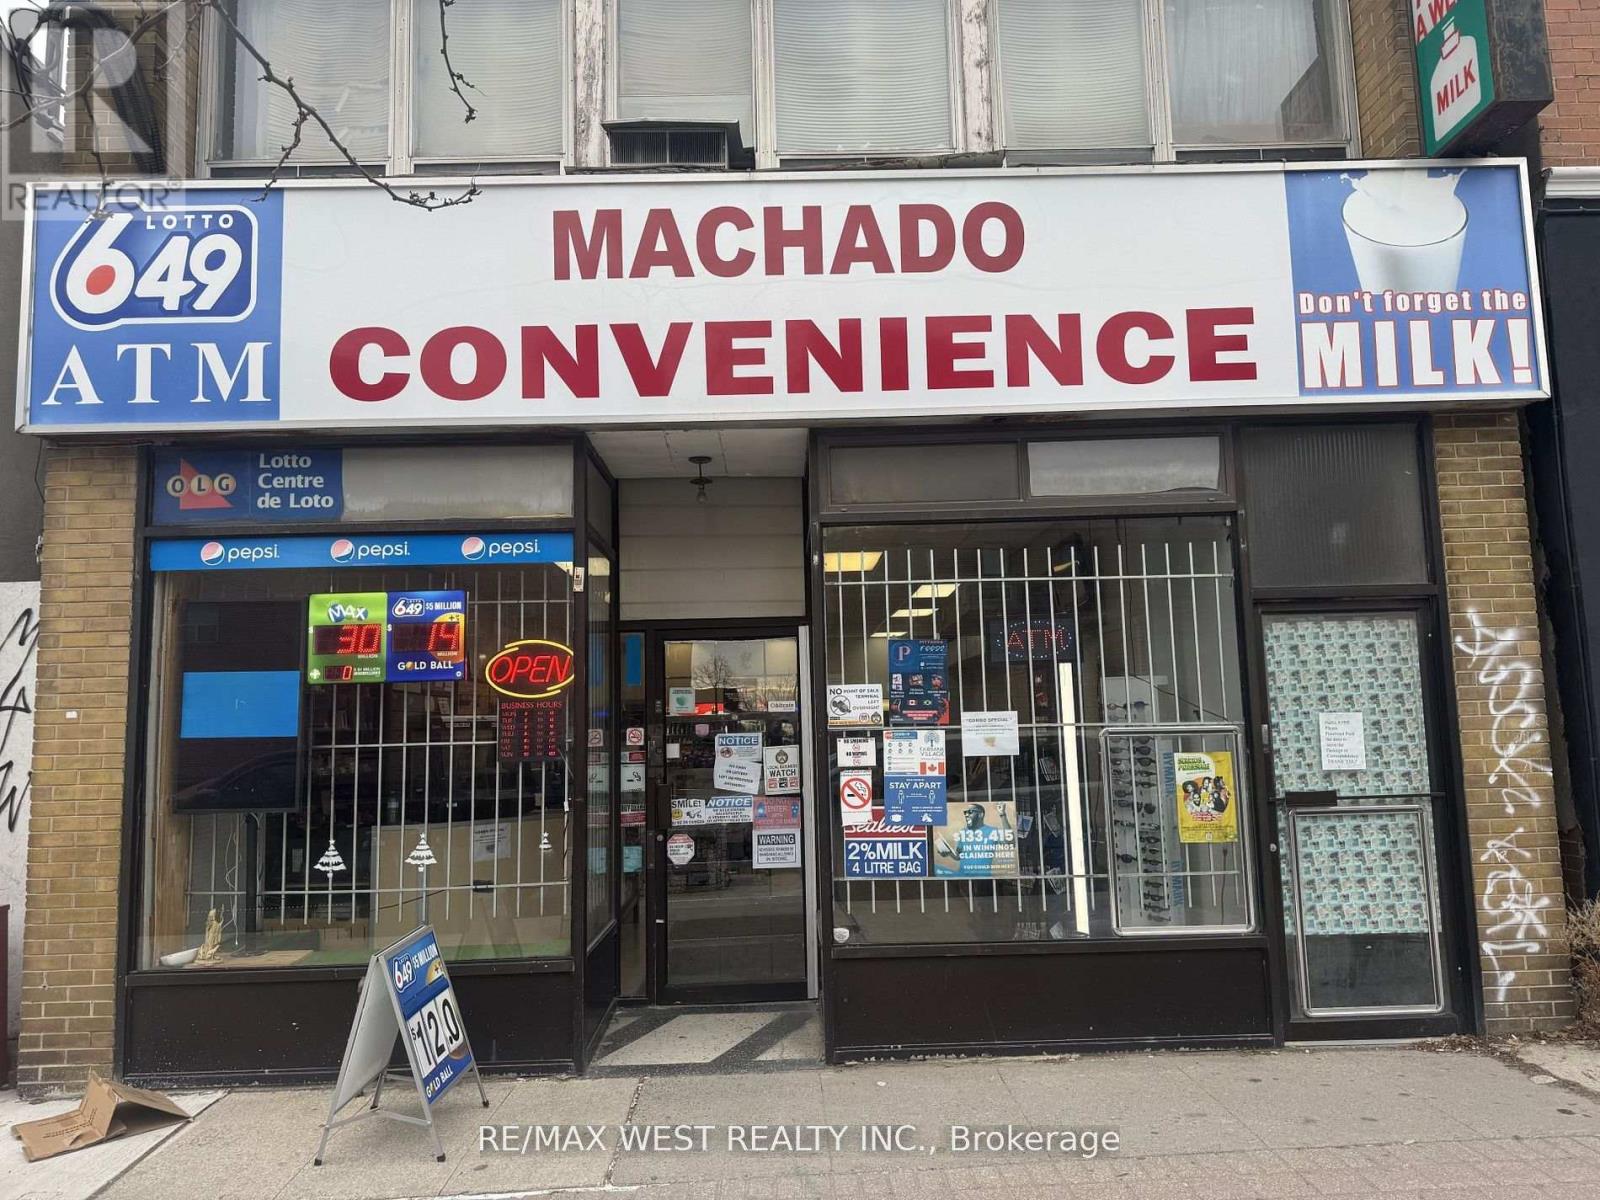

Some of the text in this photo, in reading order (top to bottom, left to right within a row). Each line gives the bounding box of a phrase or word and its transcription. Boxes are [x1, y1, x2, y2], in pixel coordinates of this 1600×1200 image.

[1416, 14, 1428, 44] A
[1436, 59, 1476, 116] MILK
[146, 213, 234, 230] LOTTO
[552, 201, 1025, 281] MACHADO
[65, 212, 243, 315] 649
[1300, 290, 1527, 315] Don't forget the
[329, 306, 1258, 403] CONVENIENCE
[1301, 318, 1534, 389] MILK!
[41, 341, 273, 406] ATM
[259, 453, 313, 469] Lotto
[168, 474, 235, 497] OLG
[257, 473, 325, 489] Centre
[256, 493, 335, 509] de Loto
[328, 604, 367, 621] MAX
[394, 599, 462, 615] 649 $5 MILLION
[337, 624, 382, 654] 30
[1007, 629, 1064, 649] ATM
[342, 665, 353, 680] 0
[430, 660, 454, 670] BALL
[491, 655, 571, 683] OPEN
[501, 701, 562, 710] BUSINESS HOURS
[719, 736, 758, 746] NOTICE
[769, 769, 796, 777] WATCH
[671, 800, 701, 809] SMILE!
[706, 798, 752, 807] NOTICE
[759, 834, 795, 844] WARNING
[953, 829, 1014, 843] $133,415
[852, 861, 922, 874] 4 LITRE BAG
[394, 943, 438, 988] 649 $5 MILLION
[440, 1065, 454, 1083] BALL
